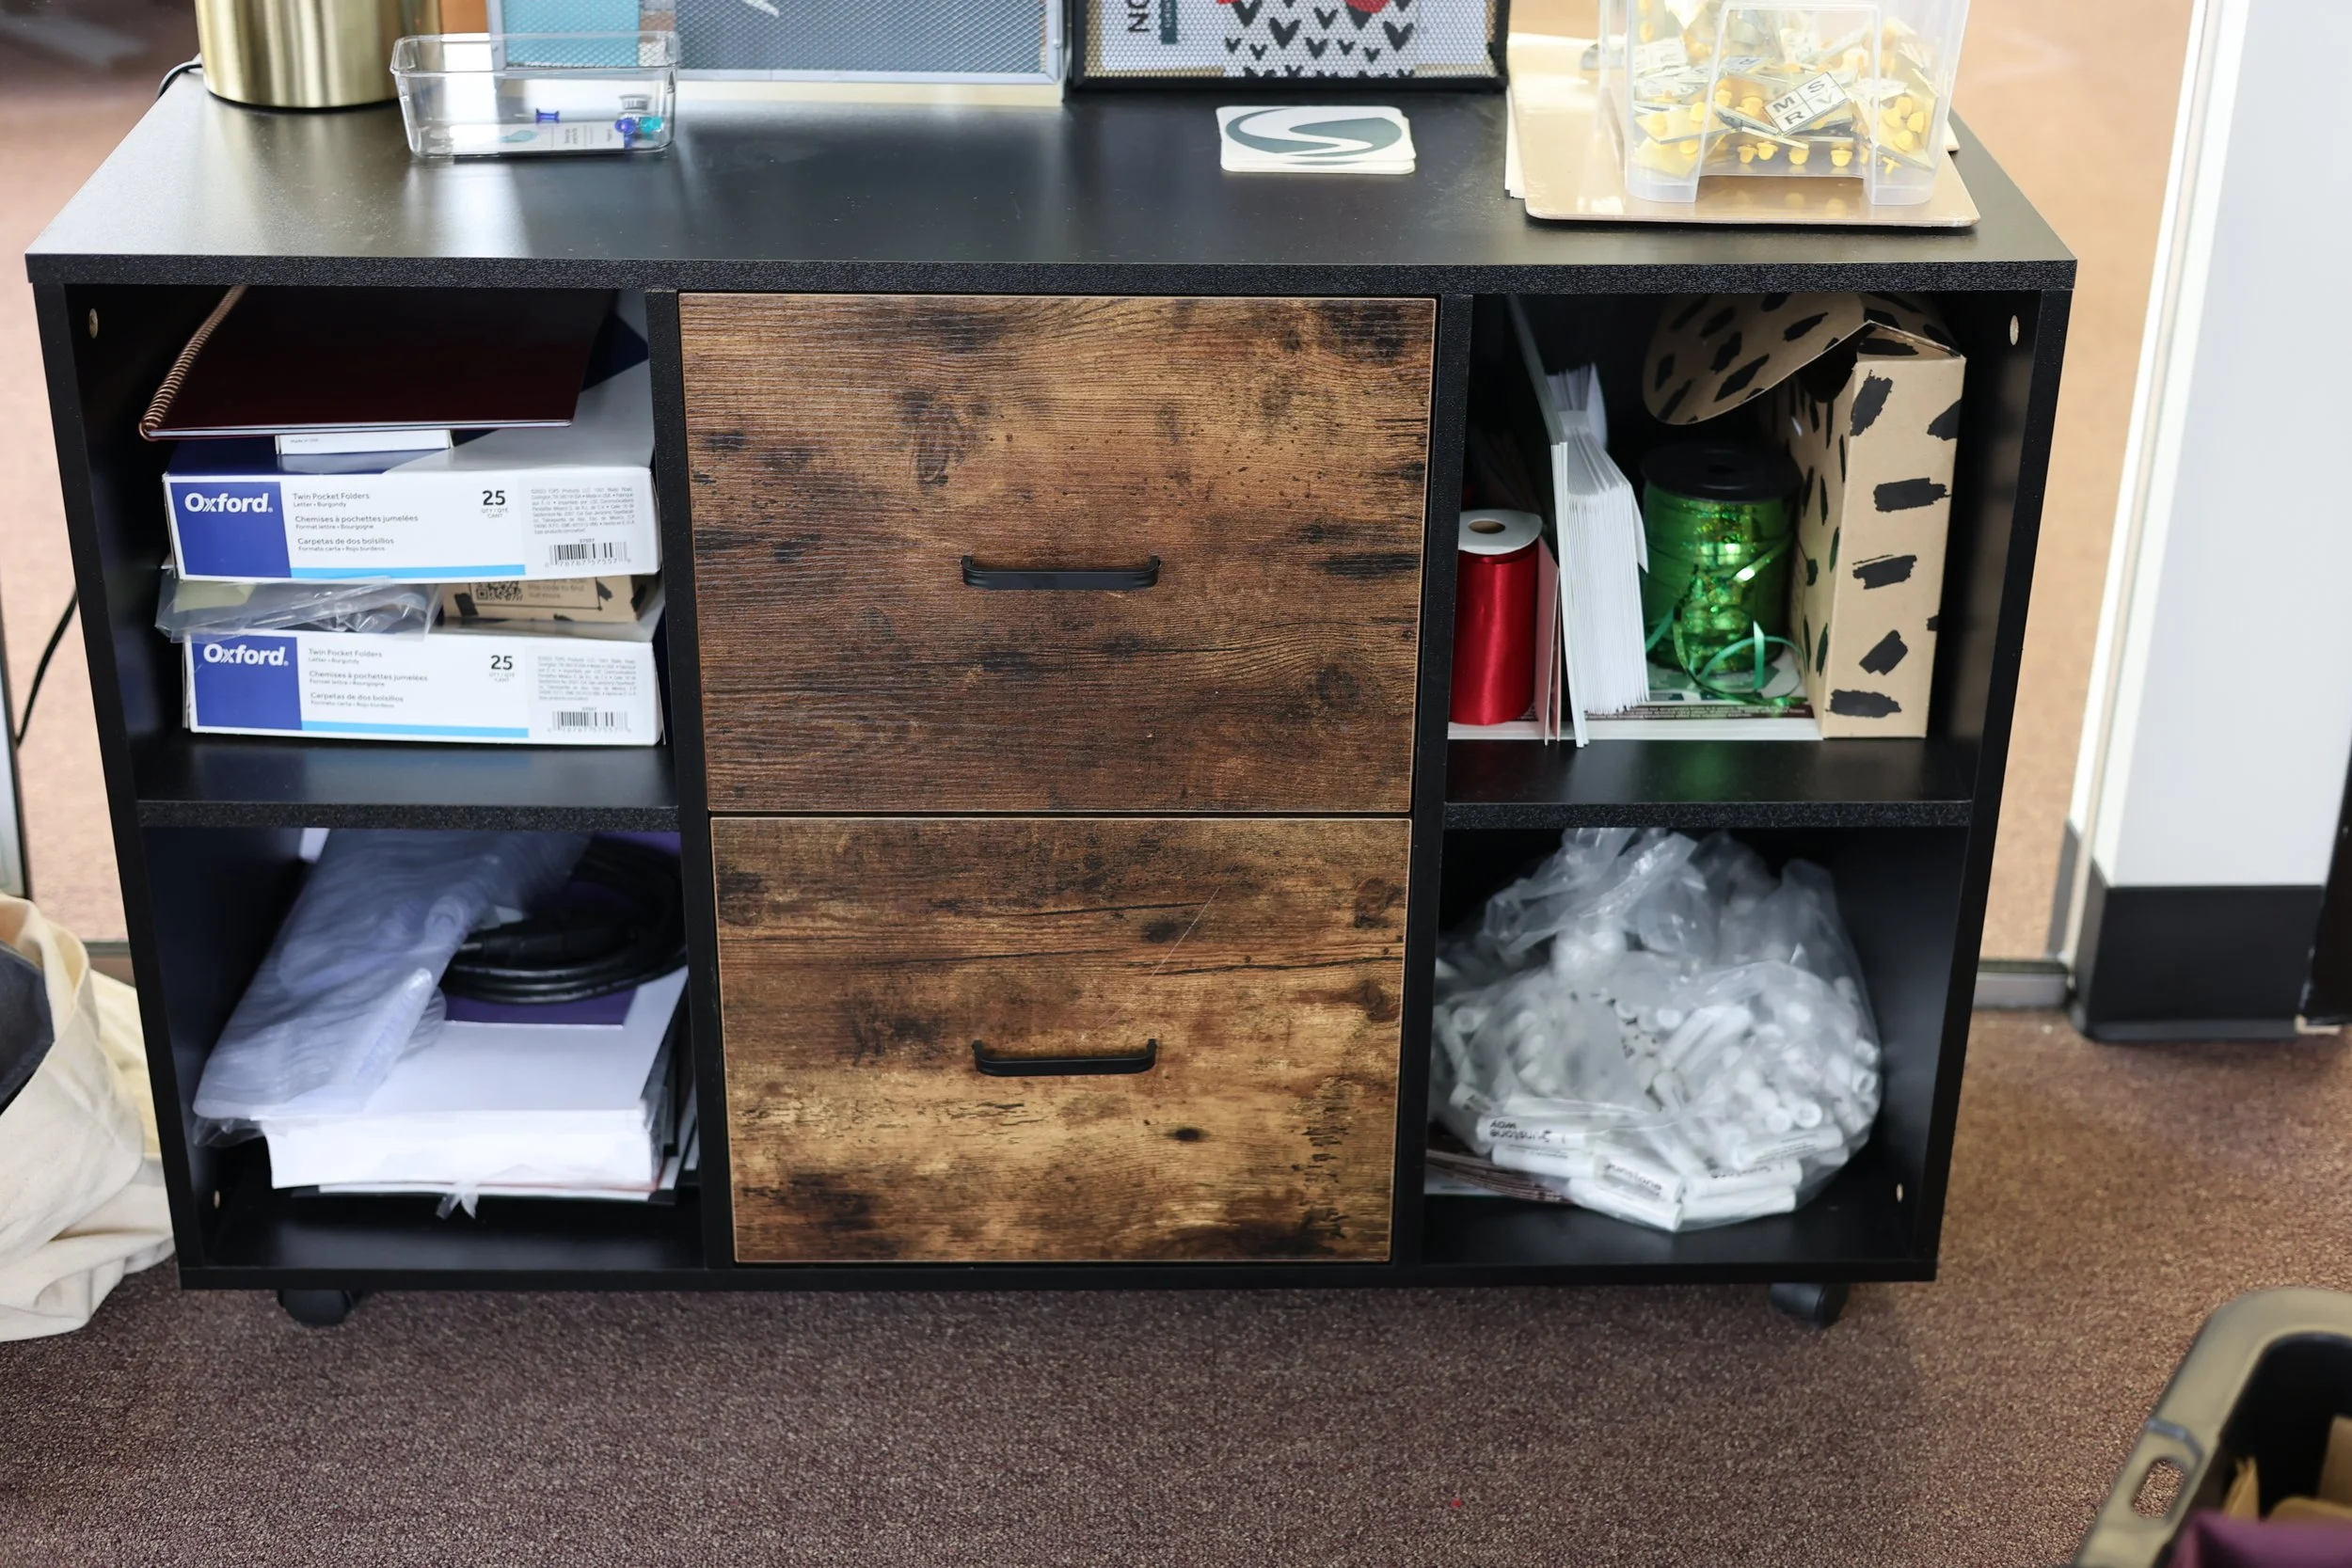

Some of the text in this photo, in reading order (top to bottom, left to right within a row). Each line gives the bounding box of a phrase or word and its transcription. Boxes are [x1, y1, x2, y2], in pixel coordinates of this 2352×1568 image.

[1772, 80, 1825, 113] M S
[1785, 110, 1805, 125] R
[312, 492, 340, 500] Pocket
[482, 490, 506, 506] 25
[184, 493, 269, 513] Oxford
[341, 515, 381, 524] pochettes
[297, 537, 334, 546] Carpetas
[203, 643, 286, 666] Oxford
[355, 650, 383, 658] Folders
[491, 655, 513, 670] 25
[309, 670, 346, 679] Chemises
[354, 672, 392, 680] pochettes
[310, 691, 345, 701] Carpetas
